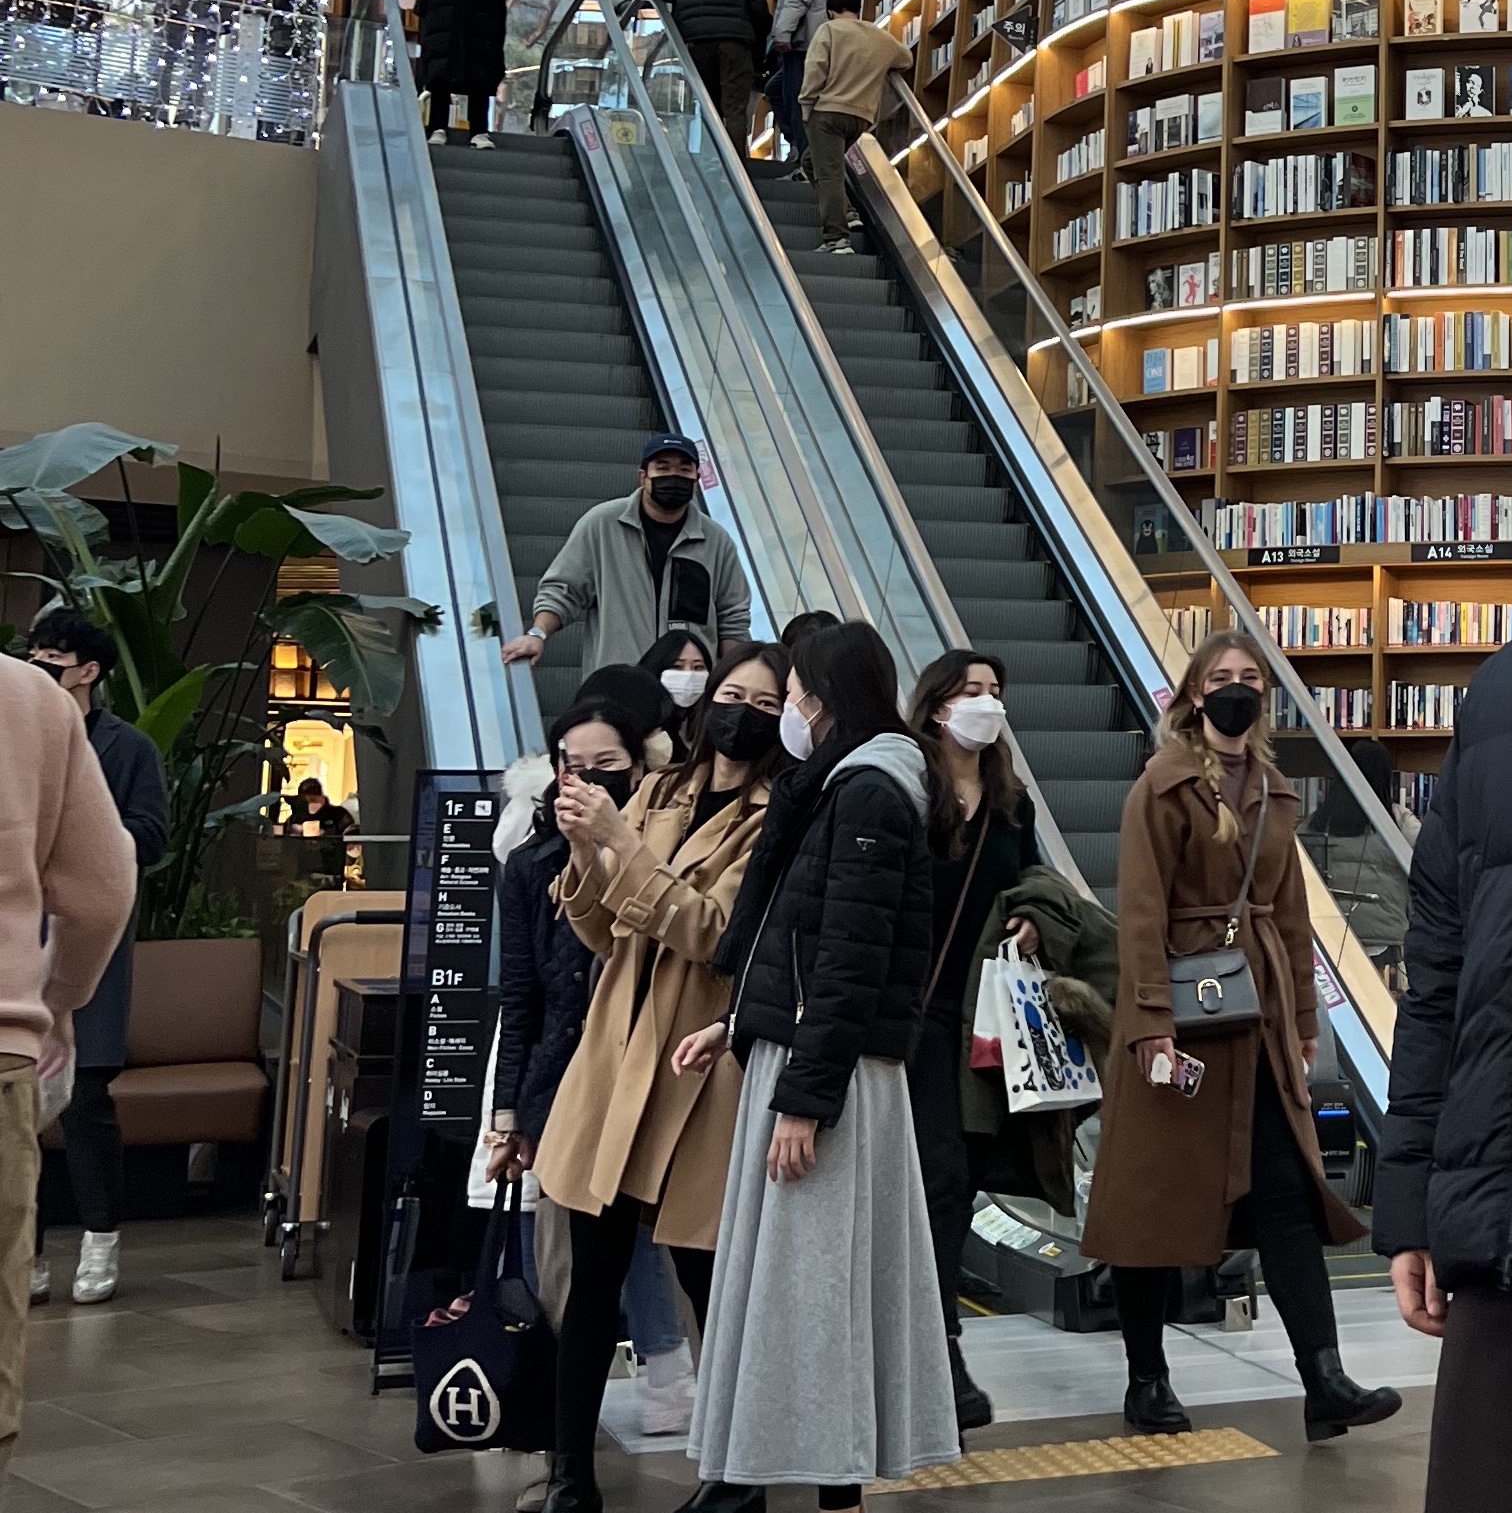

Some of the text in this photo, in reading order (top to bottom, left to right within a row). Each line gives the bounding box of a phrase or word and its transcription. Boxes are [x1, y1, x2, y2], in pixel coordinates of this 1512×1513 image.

[1003, 21, 1026, 35] 주의
[1261, 550, 1284, 563] A13
[1287, 548, 1321, 558] 외국소설
[1427, 545, 1452, 559] A14
[1457, 544, 1494, 554] 외국소설
[445, 800, 464, 816] 1F
[443, 823, 452, 834] E
[441, 855, 450, 865] F
[438, 892, 448, 902] H
[436, 922, 445, 933] G
[432, 969, 464, 986] B1F
[430, 993, 440, 1004] A
[428, 1025, 437, 1036] B
[426, 1058, 435, 1068] C
[424, 1090, 433, 1101] D
[446, 1386, 485, 1426] H
